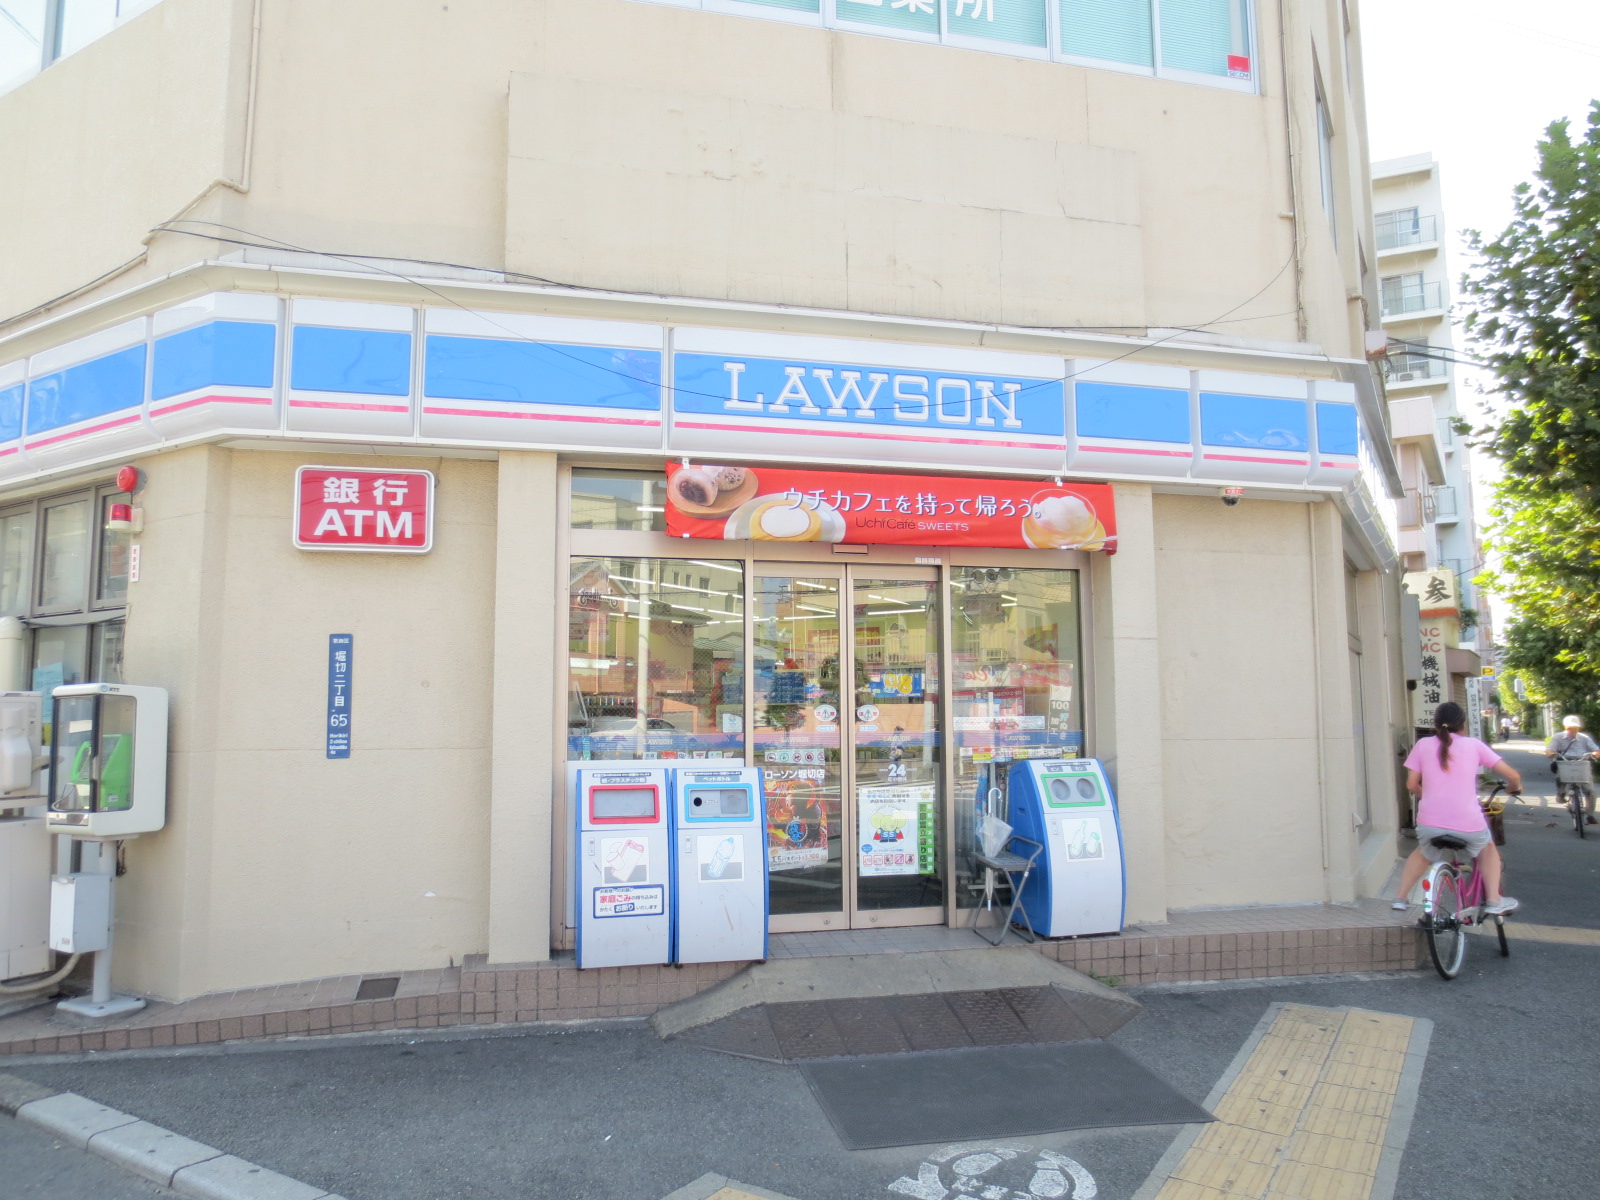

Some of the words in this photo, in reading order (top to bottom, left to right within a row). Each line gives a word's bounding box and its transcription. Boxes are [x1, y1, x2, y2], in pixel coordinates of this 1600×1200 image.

[723, 361, 1023, 429] LAWSON
[323, 476, 409, 506] 銀行
[783, 487, 1042, 519] ウチカフェを持って帰ろう。
[313, 508, 413, 538] ATM
[917, 522, 969, 532] SWEETS
[1424, 576, 1452, 604] 参
[334, 650, 347, 707] 堀切二丁目
[1421, 655, 1441, 704] 機械油
[330, 713, 348, 727] 65
[888, 764, 907, 777] 24
